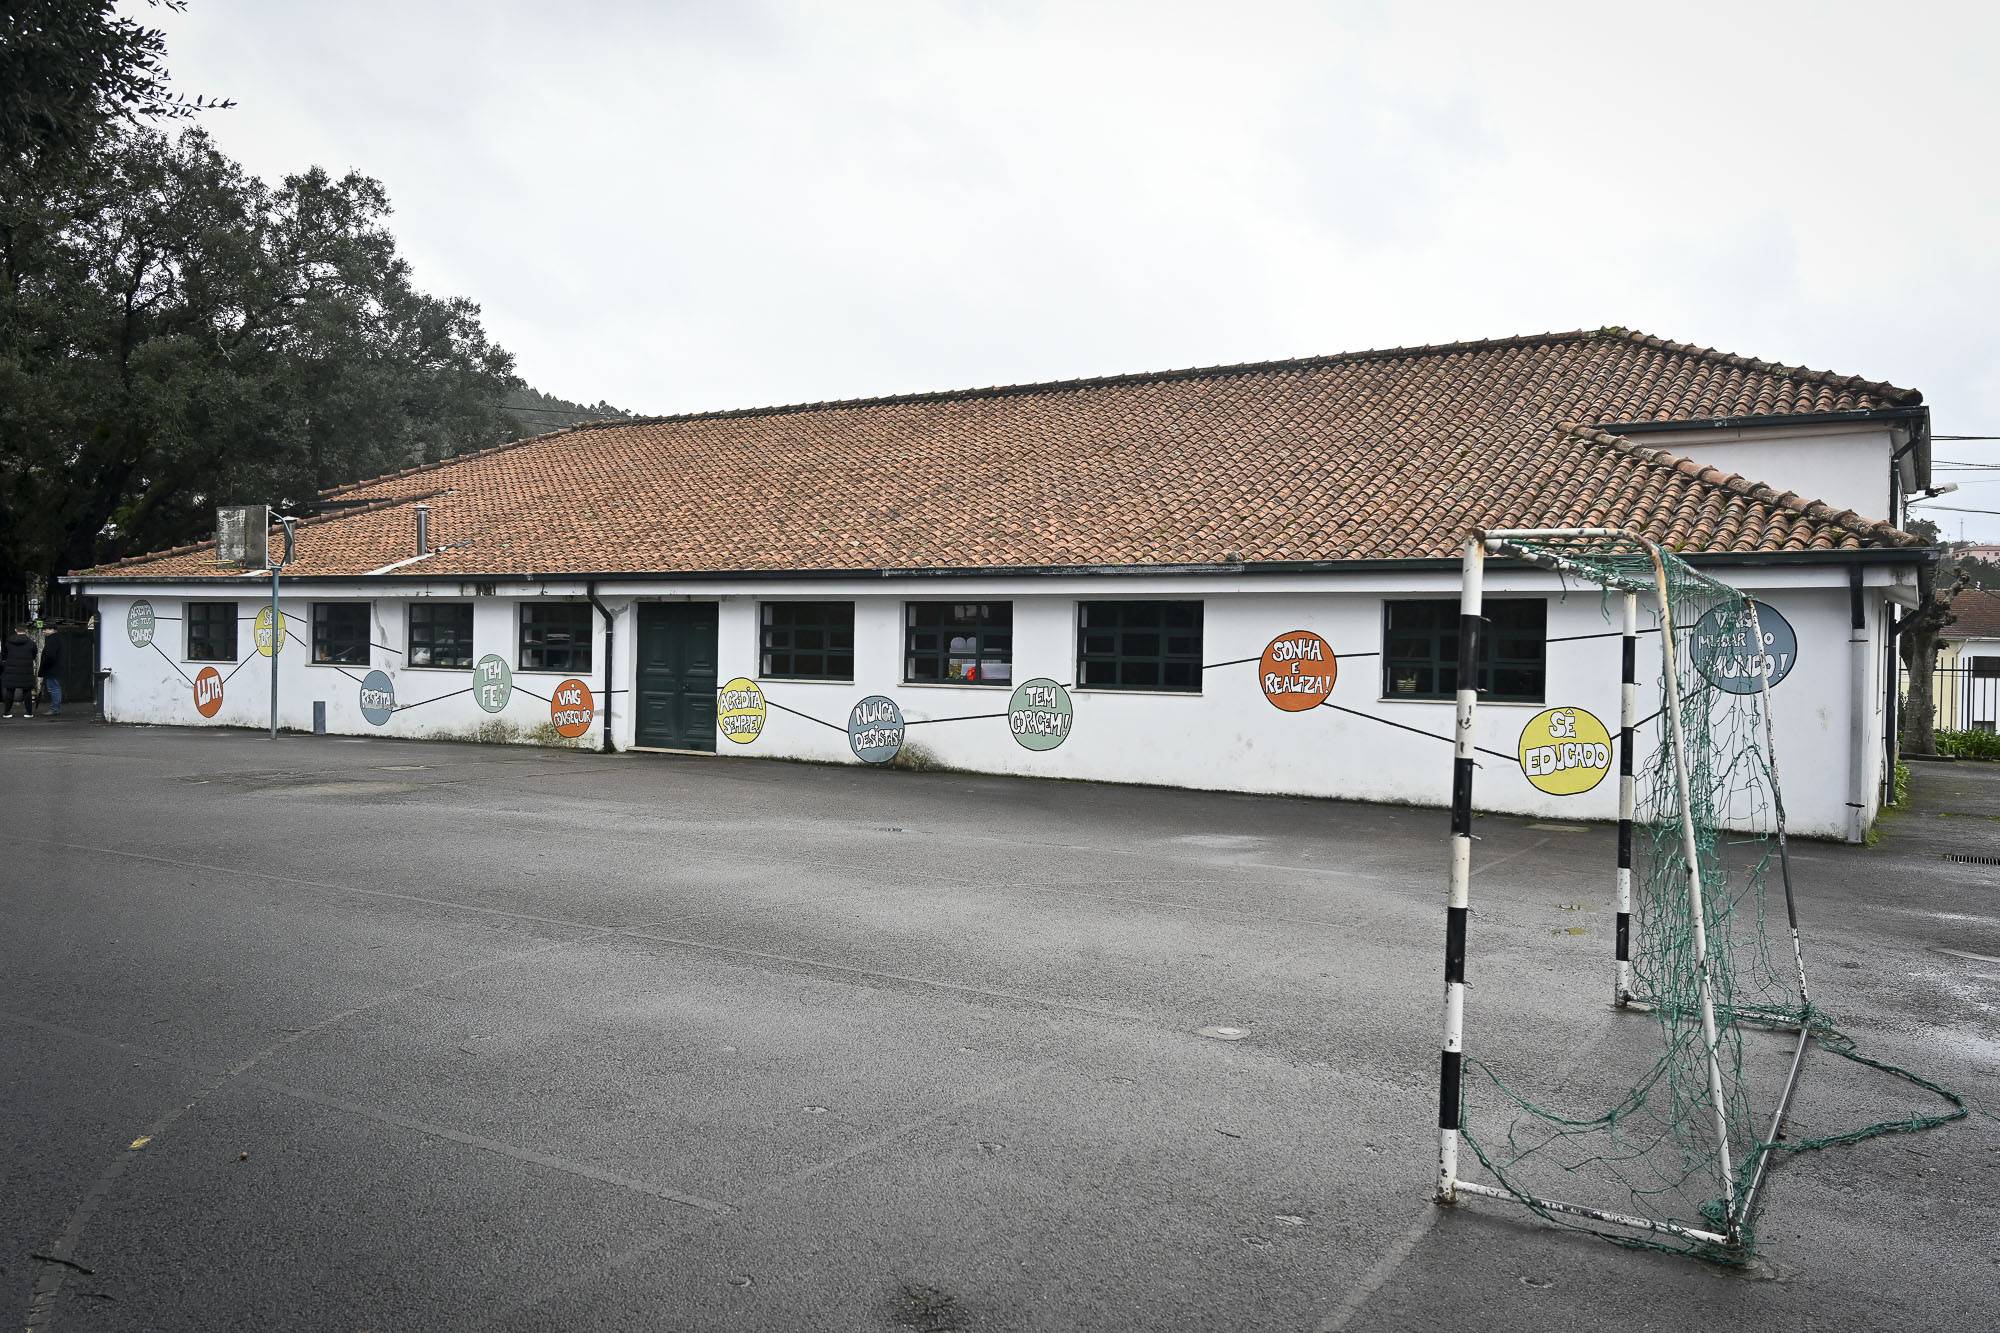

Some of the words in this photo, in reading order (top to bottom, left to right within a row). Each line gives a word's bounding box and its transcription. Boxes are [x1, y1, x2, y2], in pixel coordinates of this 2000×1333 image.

[1713, 609, 1753, 629] VIS
[1762, 631, 1776, 645] O
[1272, 638, 1324, 662] SONHA
[480, 660, 502, 682] TEM
[1291, 661, 1301, 674] E
[196, 674, 222, 707] LUTA
[557, 683, 581, 706] VAIS
[1264, 672, 1331, 695] REALIZA!
[719, 686, 763, 715] ACREDITA
[1025, 686, 1057, 708] TEM
[855, 700, 896, 726] NUNCA
[1010, 710, 1071, 737] CORAGEM!
[1548, 708, 1577, 738] SÊ
[723, 715, 762, 735] SEMPRE!
[854, 724, 903, 752] DESISTAS!
[1525, 743, 1609, 776] EDUCADO
